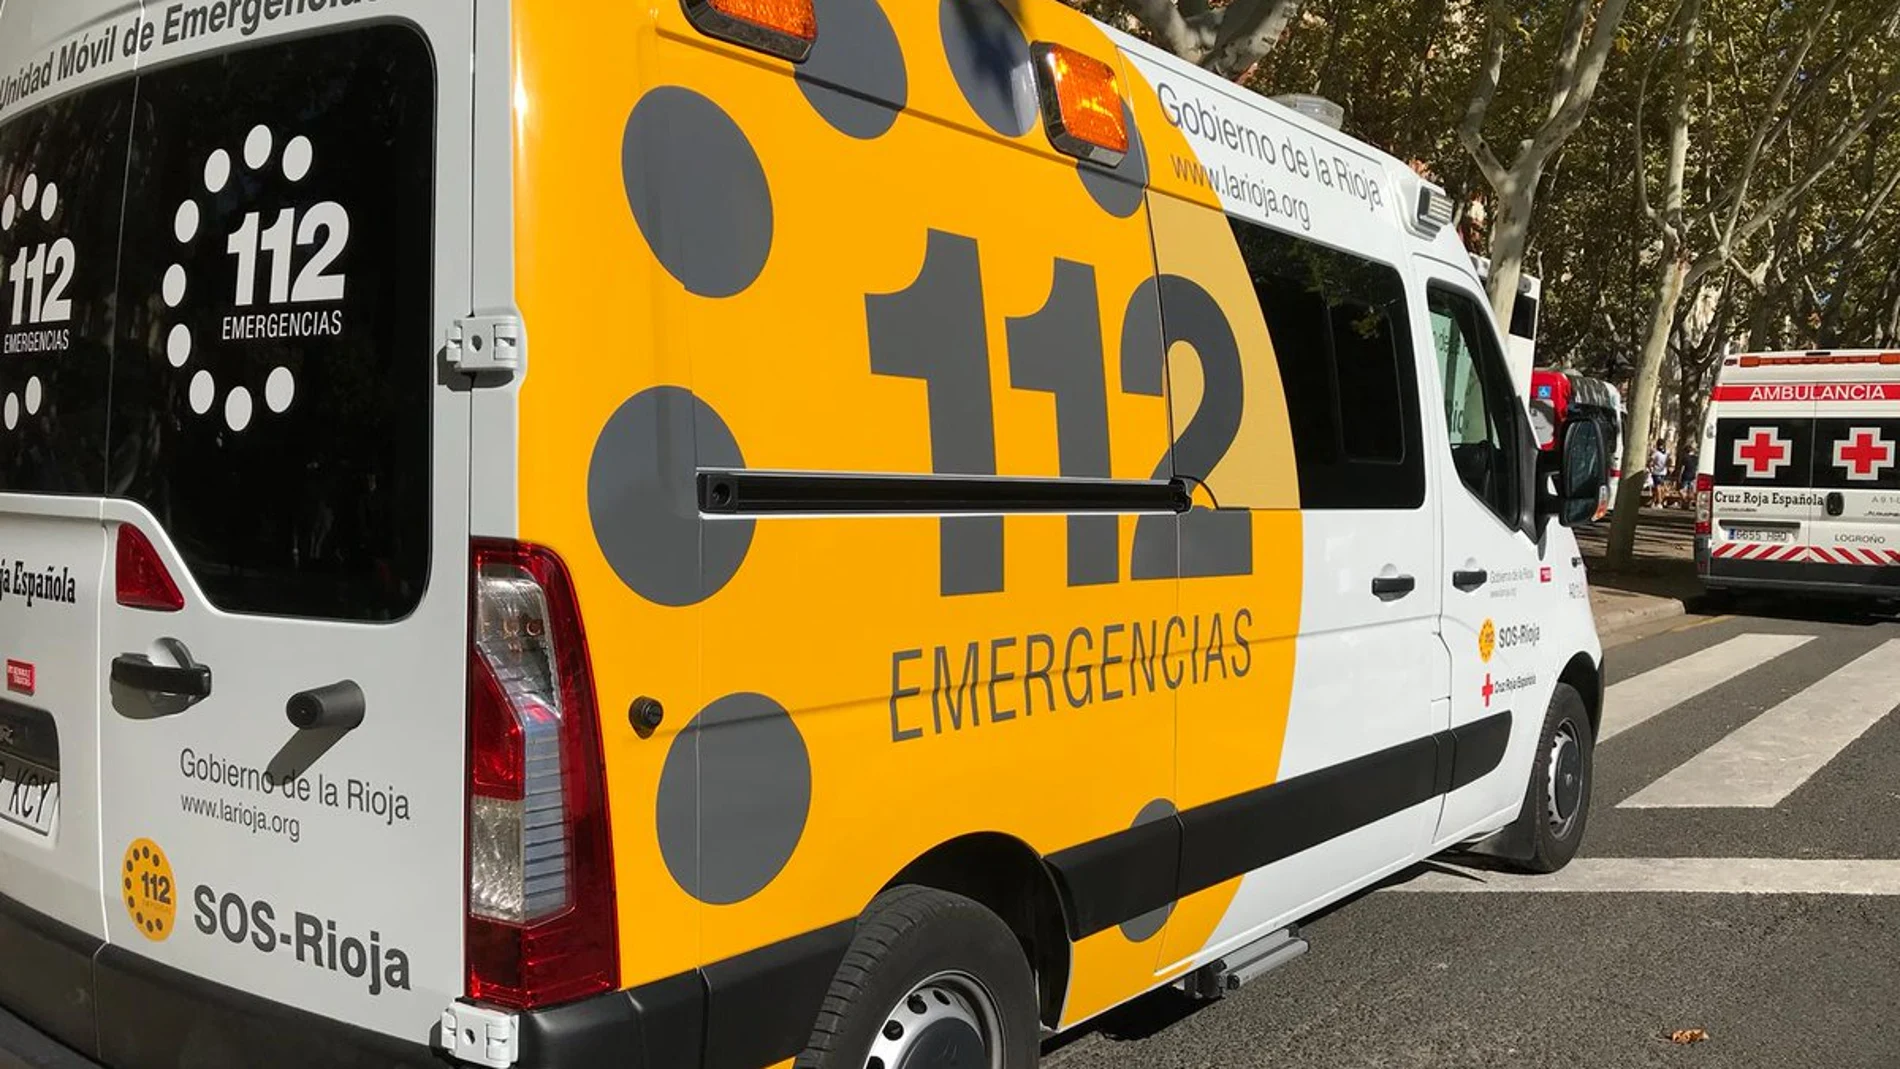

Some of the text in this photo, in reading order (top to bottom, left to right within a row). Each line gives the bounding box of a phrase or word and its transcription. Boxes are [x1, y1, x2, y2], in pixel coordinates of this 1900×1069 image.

[57, 24, 118, 82] Móvil
[122, 16, 155, 57] de
[1157, 82, 1384, 213] Gobierno de la Rioja
[1170, 152, 1312, 232] www.larioja.org
[9, 236, 76, 326] 112
[227, 200, 350, 307] 112
[3, 328, 70, 354] EMERGENCIAS
[222, 309, 343, 341] EMERGENCIAS
[863, 226, 1254, 597] 112
[1749, 384, 1886, 401] AMBULANCIA
[1714, 490, 1825, 508] Cruz Roja Española
[1834, 533, 1886, 544] LOGROÑO
[13, 560, 76, 608] Española
[1498, 622, 1540, 649] SOS-Rioja
[888, 607, 1254, 743] EMERGENCIAS
[9, 766, 53, 824] KCY
[180, 747, 411, 826] Gobierno de la Rioja
[180, 793, 301, 844] www.larioja.org
[141, 870, 172, 905] 112
[193, 884, 412, 996] SOS-Rioja
